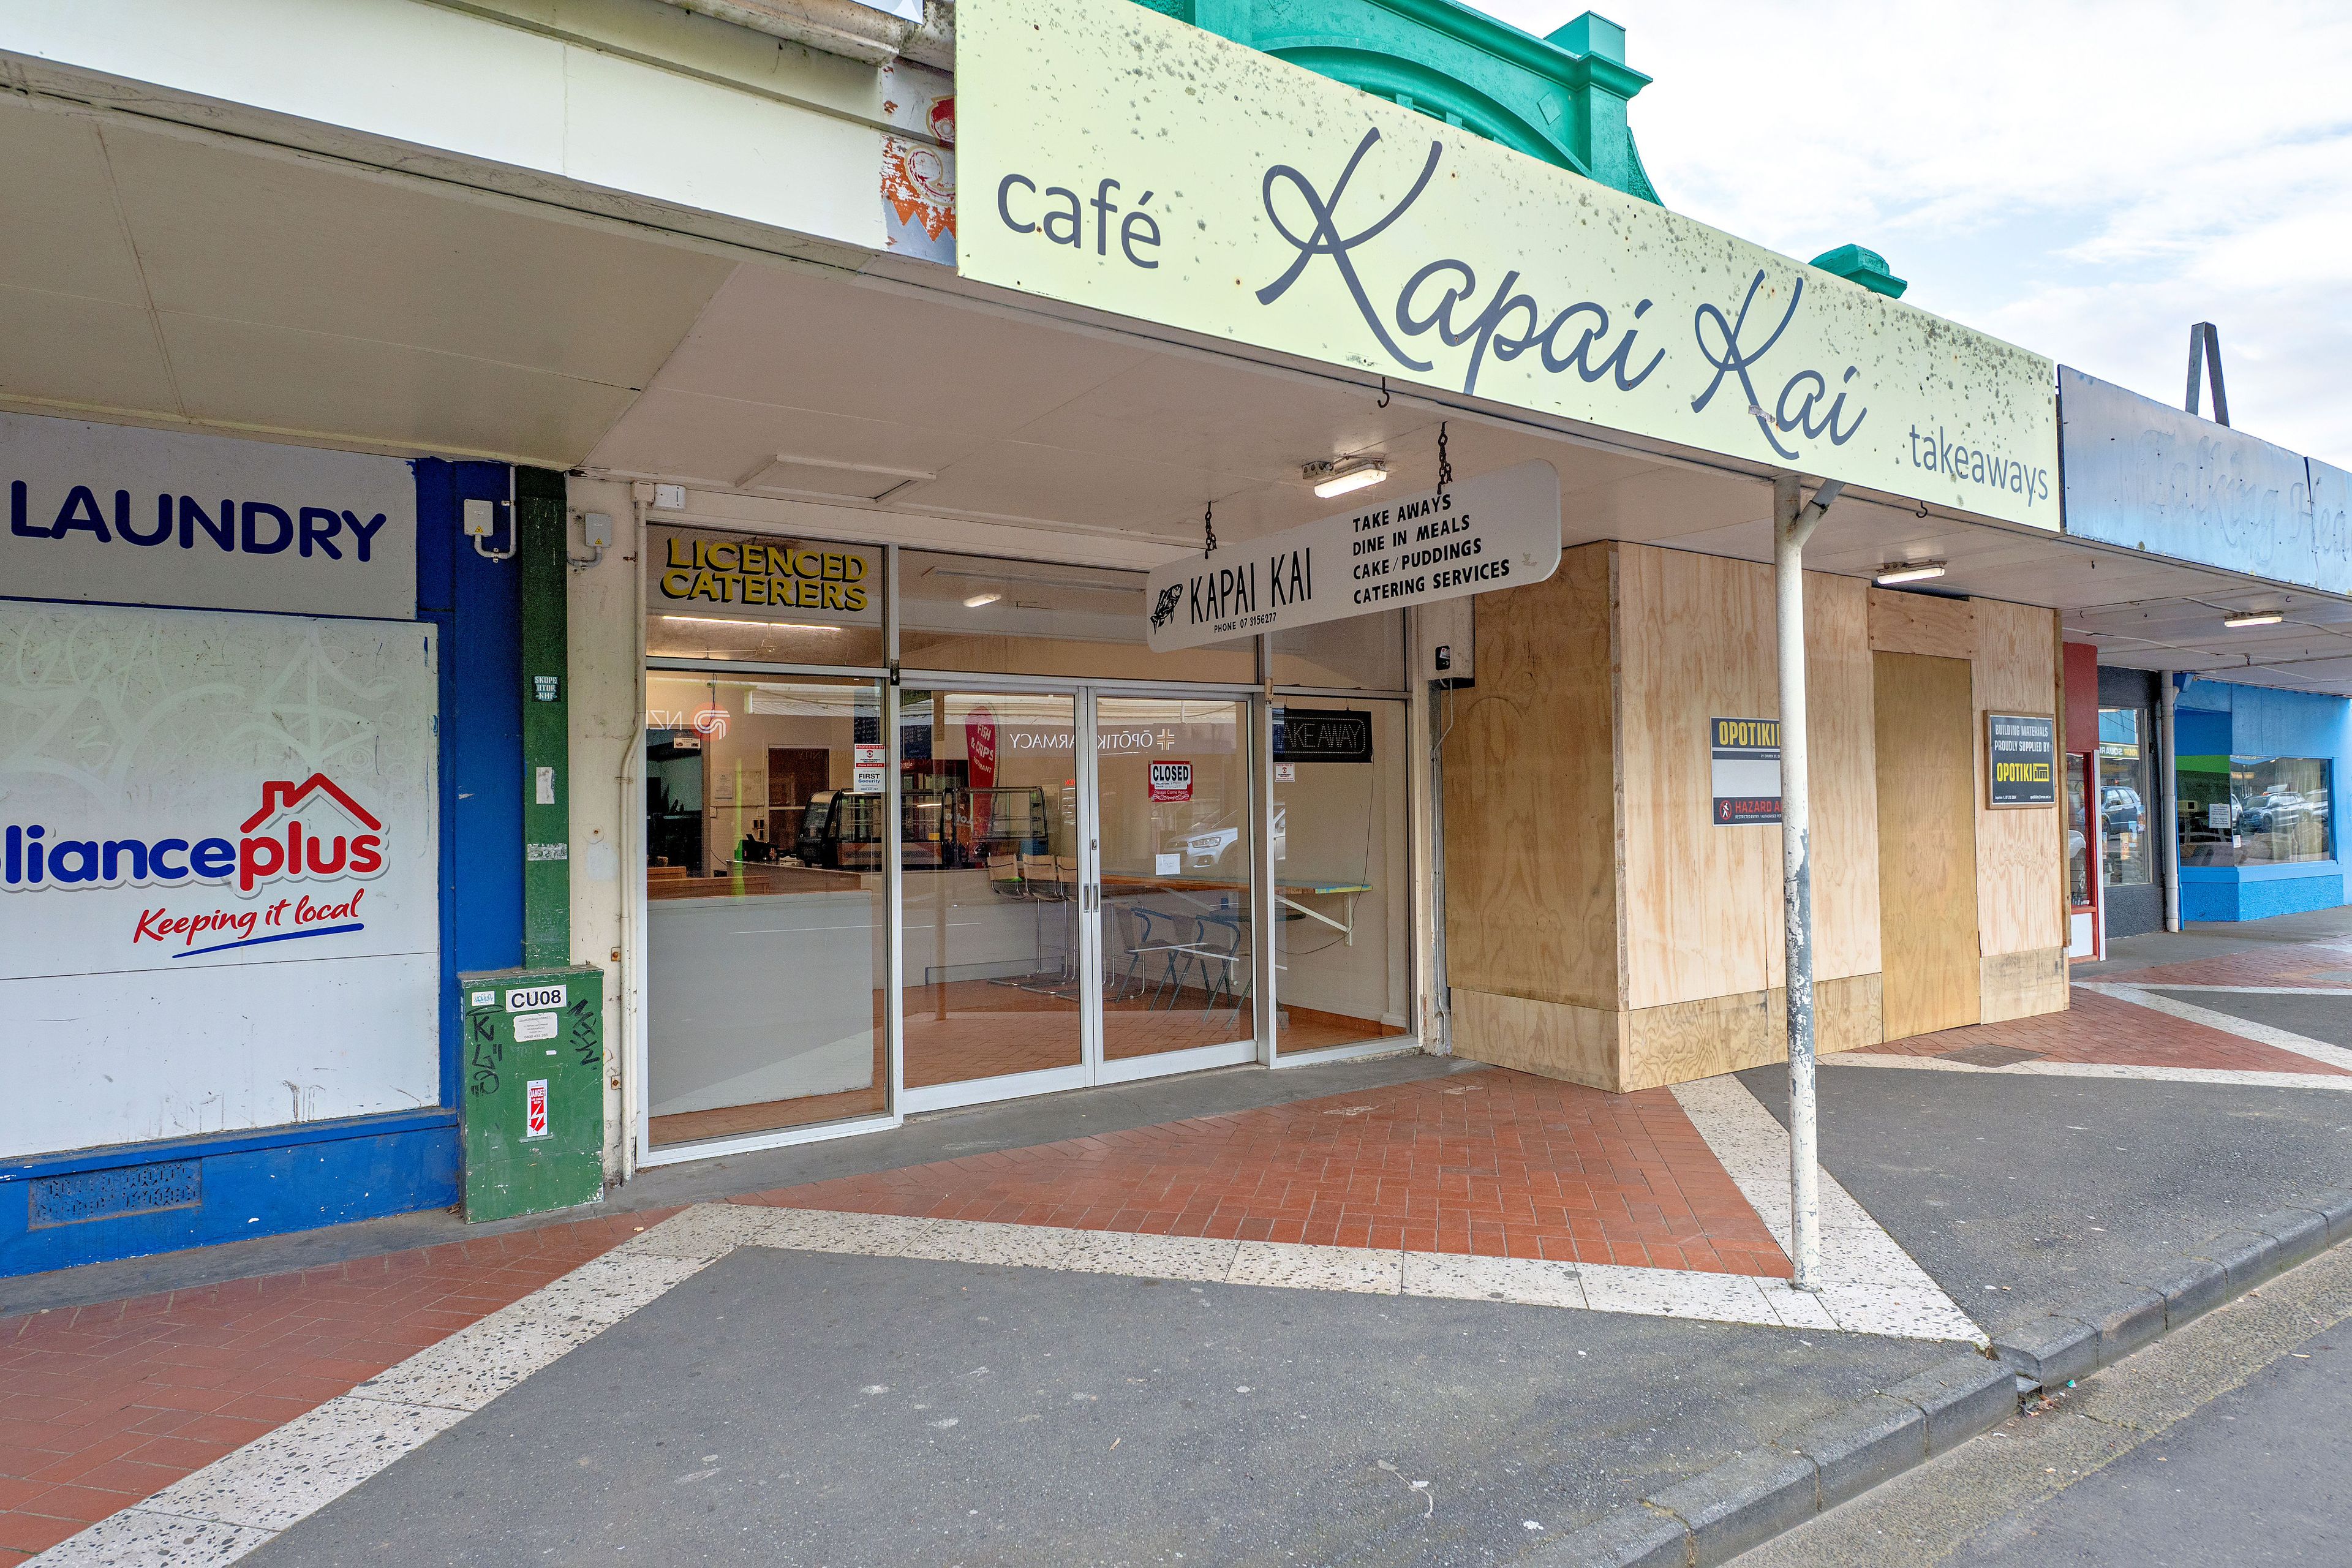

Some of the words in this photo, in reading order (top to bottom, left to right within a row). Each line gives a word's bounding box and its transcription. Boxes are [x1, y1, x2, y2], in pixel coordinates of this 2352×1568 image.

[998, 173, 1161, 268] café
[1255, 126, 1665, 396] Kapai
[1691, 269, 1867, 460] Kai
[1909, 424, 2048, 507] takeaways
[10, 480, 386, 562] LAUNDRY
[1352, 512, 1389, 533] TAKE
[1397, 494, 1452, 523] AWAYS
[1352, 536, 1385, 556] DINE
[1393, 532, 1407, 546] IN
[1417, 514, 1470, 543] MEALS
[666, 538, 868, 582] LICENCED
[660, 569, 868, 611] CATERERS
[1191, 562, 1256, 625] KAPAI
[1271, 548, 1311, 607] KAI
[1353, 576, 1425, 605] CATERING
[1432, 559, 1510, 589] SERVICES
[1214, 621, 1236, 633] PHONE
[1240, 618, 1247, 629] 07
[1250, 612, 1276, 627] 3156277
[978, 723, 992, 741] FISH
[1719, 722, 1775, 746] OPOTIKI
[1994, 741, 2018, 752] PROUDLY
[2019, 741, 2042, 752] SUPPLIED
[2043, 742, 2049, 752] BY
[1996, 725, 2019, 736] BUILDING
[2021, 726, 2048, 737] MATERIALS
[971, 737, 975, 749] &
[976, 741, 993, 761] CHIPS
[1153, 766, 1188, 781] CLOSED
[1997, 763, 2032, 782] OPOTIKI
[1735, 801, 1772, 813] HAZARD
[133, 907, 257, 945] Keeping
[265, 898, 290, 926] it
[294, 888, 365, 923] local
[511, 990, 561, 1008] CU08
[529, 1088, 546, 1098] DANGER
